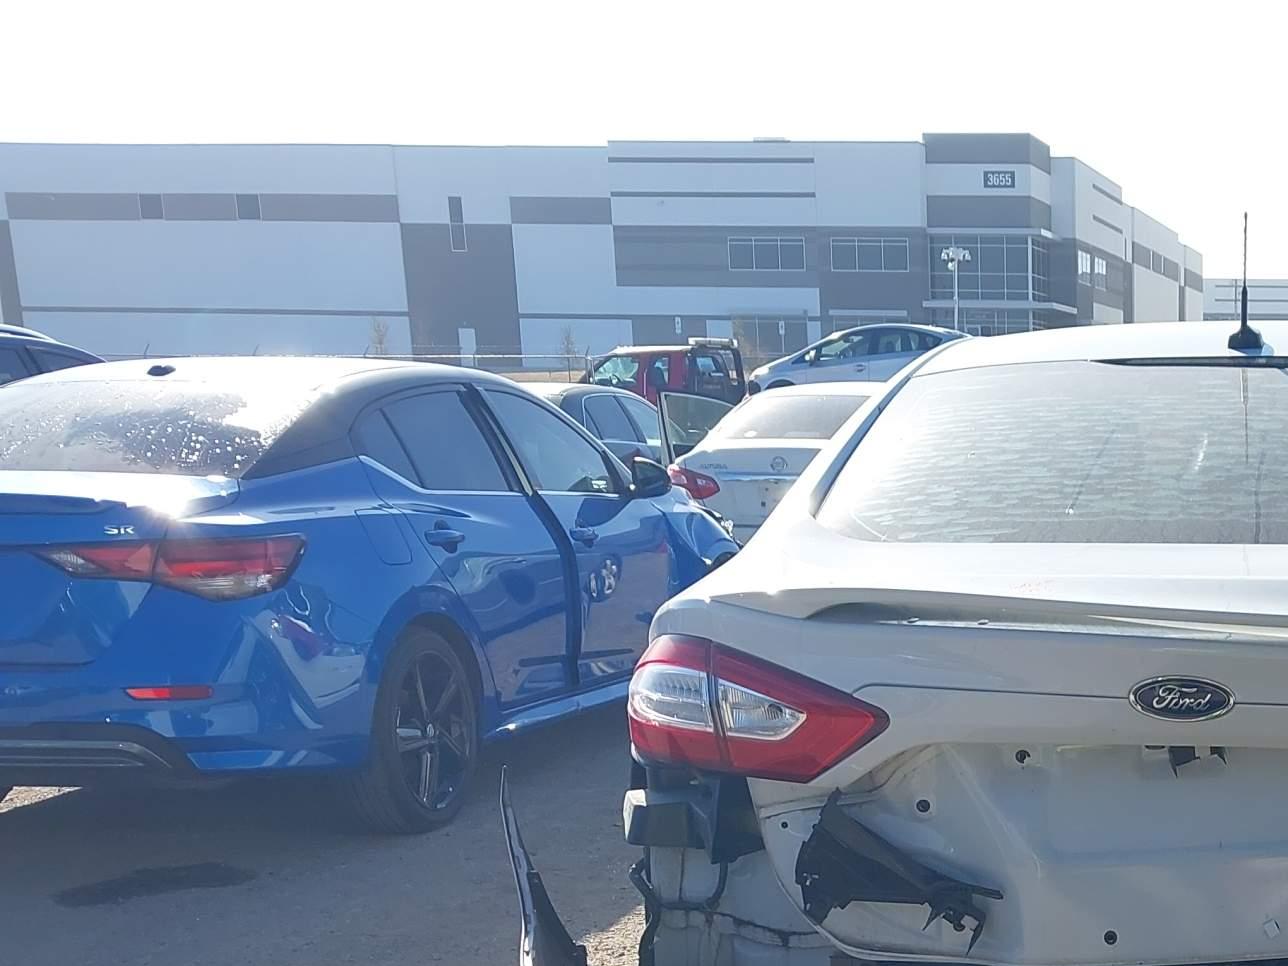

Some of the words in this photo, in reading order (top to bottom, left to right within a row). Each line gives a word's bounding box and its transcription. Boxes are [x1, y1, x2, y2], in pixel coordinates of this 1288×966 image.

[987, 173, 1012, 186] 3655
[103, 524, 135, 535] SR
[1152, 684, 1212, 710] Ford
